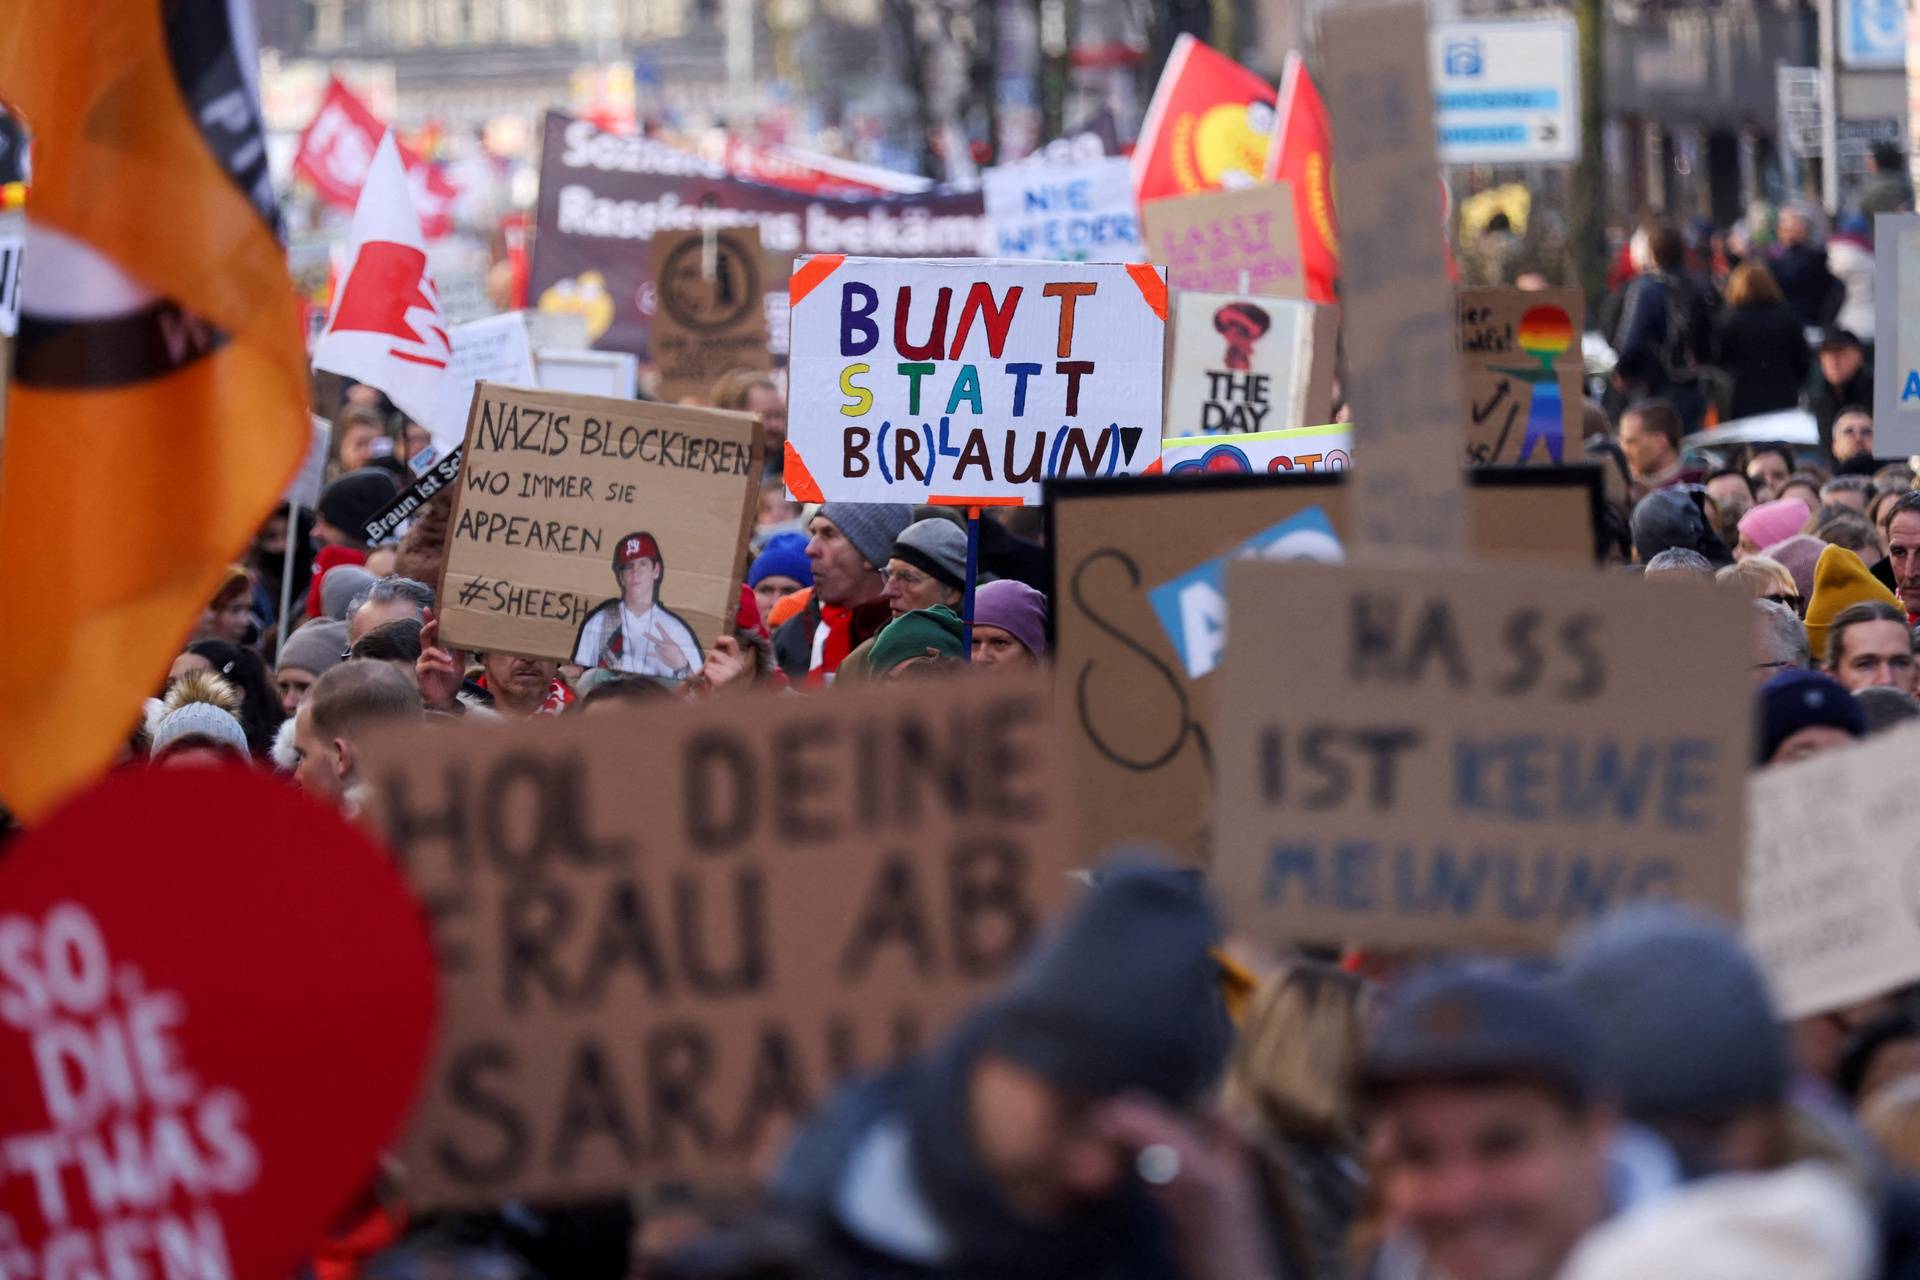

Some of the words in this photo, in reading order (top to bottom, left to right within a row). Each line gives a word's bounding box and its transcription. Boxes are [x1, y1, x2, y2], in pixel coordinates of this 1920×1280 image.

[840, 281, 1098, 361] BUNT
[839, 361, 1096, 418] STATT
[1201, 402, 1271, 434] DAY
[1206, 370, 1271, 404] THE
[474, 400, 570, 456] NAZIS
[580, 417, 754, 477] BLOCKIEREN
[365, 495, 421, 541] Braun
[414, 474, 442, 499] ist
[467, 465, 510, 495] WO
[517, 473, 593, 500] IMMER
[604, 482, 637, 504] SIE
[455, 508, 602, 554] APPEAREN
[458, 574, 589, 626] #SHEESH
[1344, 592, 1610, 703] HASS
[380, 750, 638, 870] HOL
[680, 695, 1050, 855] DEINE
[1256, 724, 1420, 808] IST
[1448, 730, 1720, 837] KEINE
[838, 835, 1040, 982] AB
[32, 988, 198, 1128] DIE
